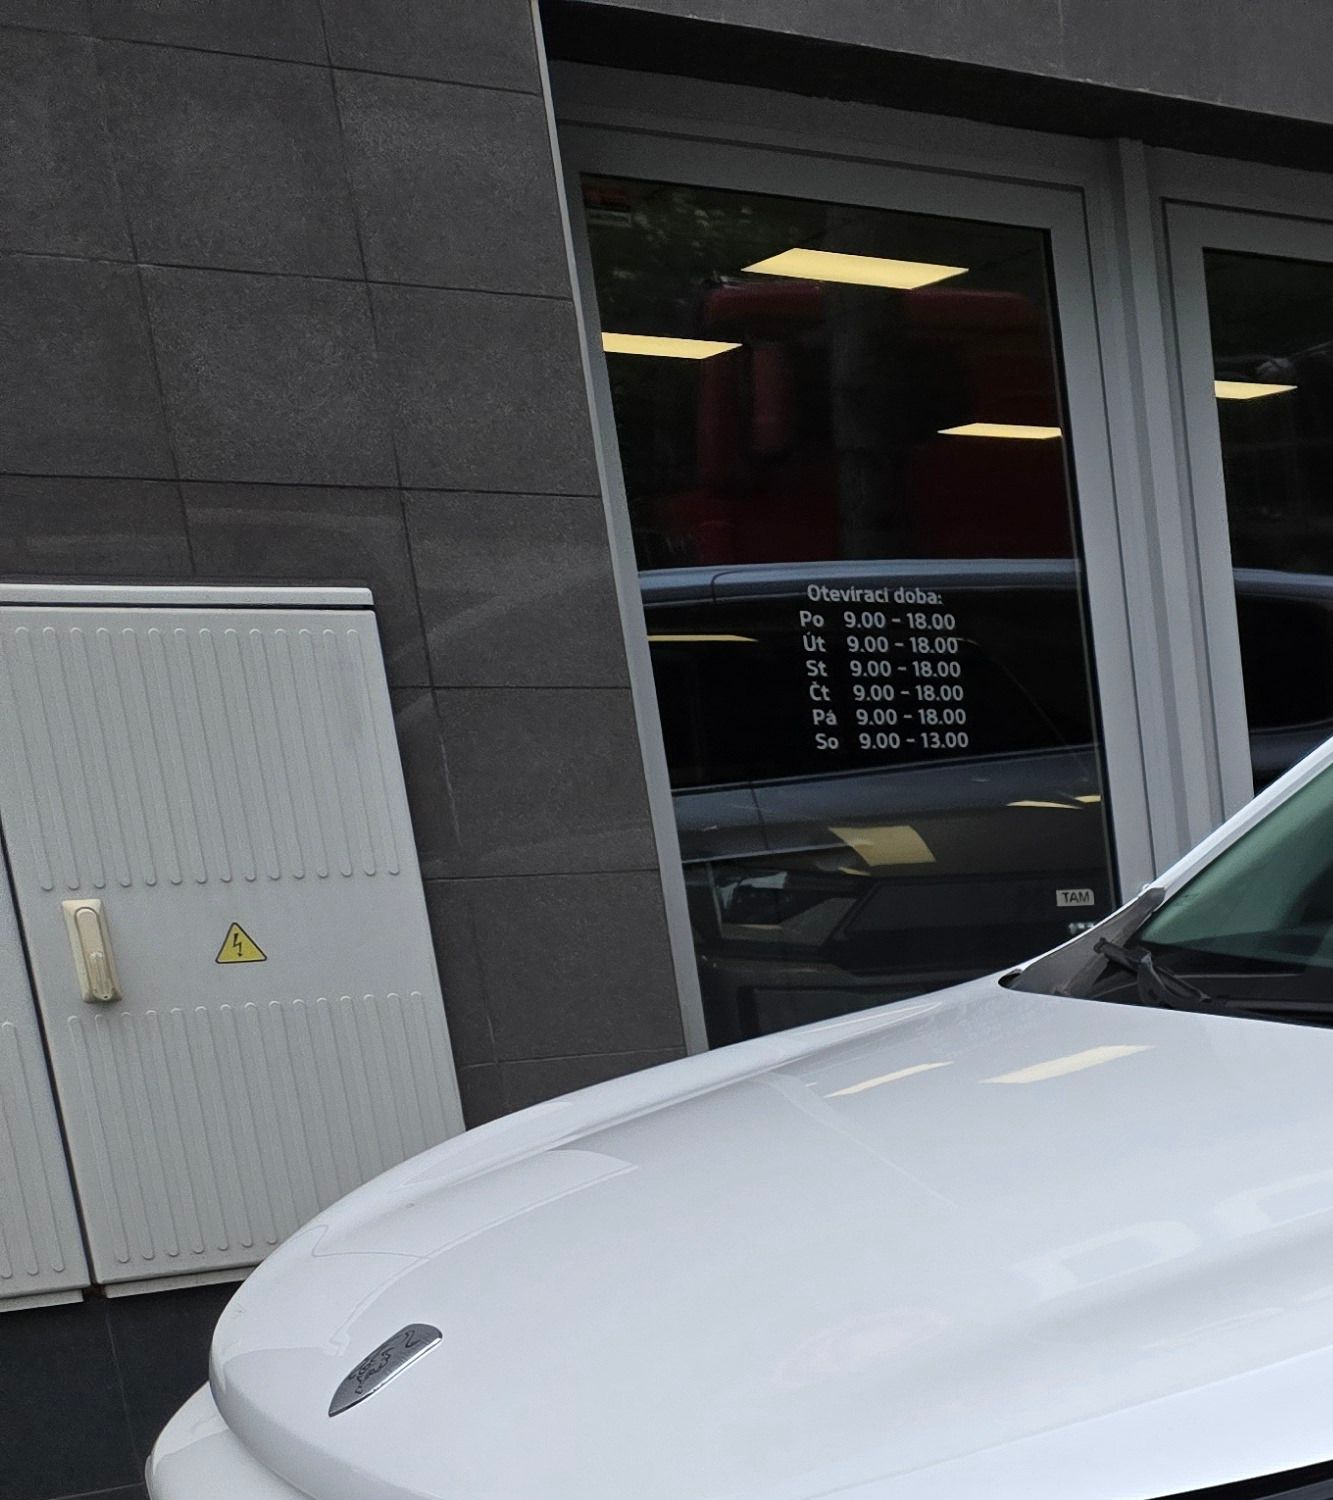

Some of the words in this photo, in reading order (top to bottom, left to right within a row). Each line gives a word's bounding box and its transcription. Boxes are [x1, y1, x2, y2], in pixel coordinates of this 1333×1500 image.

[893, 587, 943, 604] doba:
[800, 611, 825, 627] Po
[843, 611, 886, 628] 9.00
[906, 613, 956, 630] 18.00
[803, 632, 827, 652] Út
[847, 636, 889, 652] 9.00
[909, 637, 958, 653] 18.00
[806, 660, 829, 677] St
[850, 660, 892, 677] 9.00
[912, 661, 961, 677] 18.00
[809, 681, 832, 701] Čt
[853, 684, 895, 701] 9.00
[915, 685, 964, 701] 18.00
[812, 708, 838, 726] Pá
[856, 708, 898, 726] 9.00
[918, 708, 967, 725] 18.00
[815, 733, 840, 750] So
[859, 732, 900, 749] 9.00
[920, 732, 969, 749] 13.00
[1061, 890, 1091, 904] TAM
